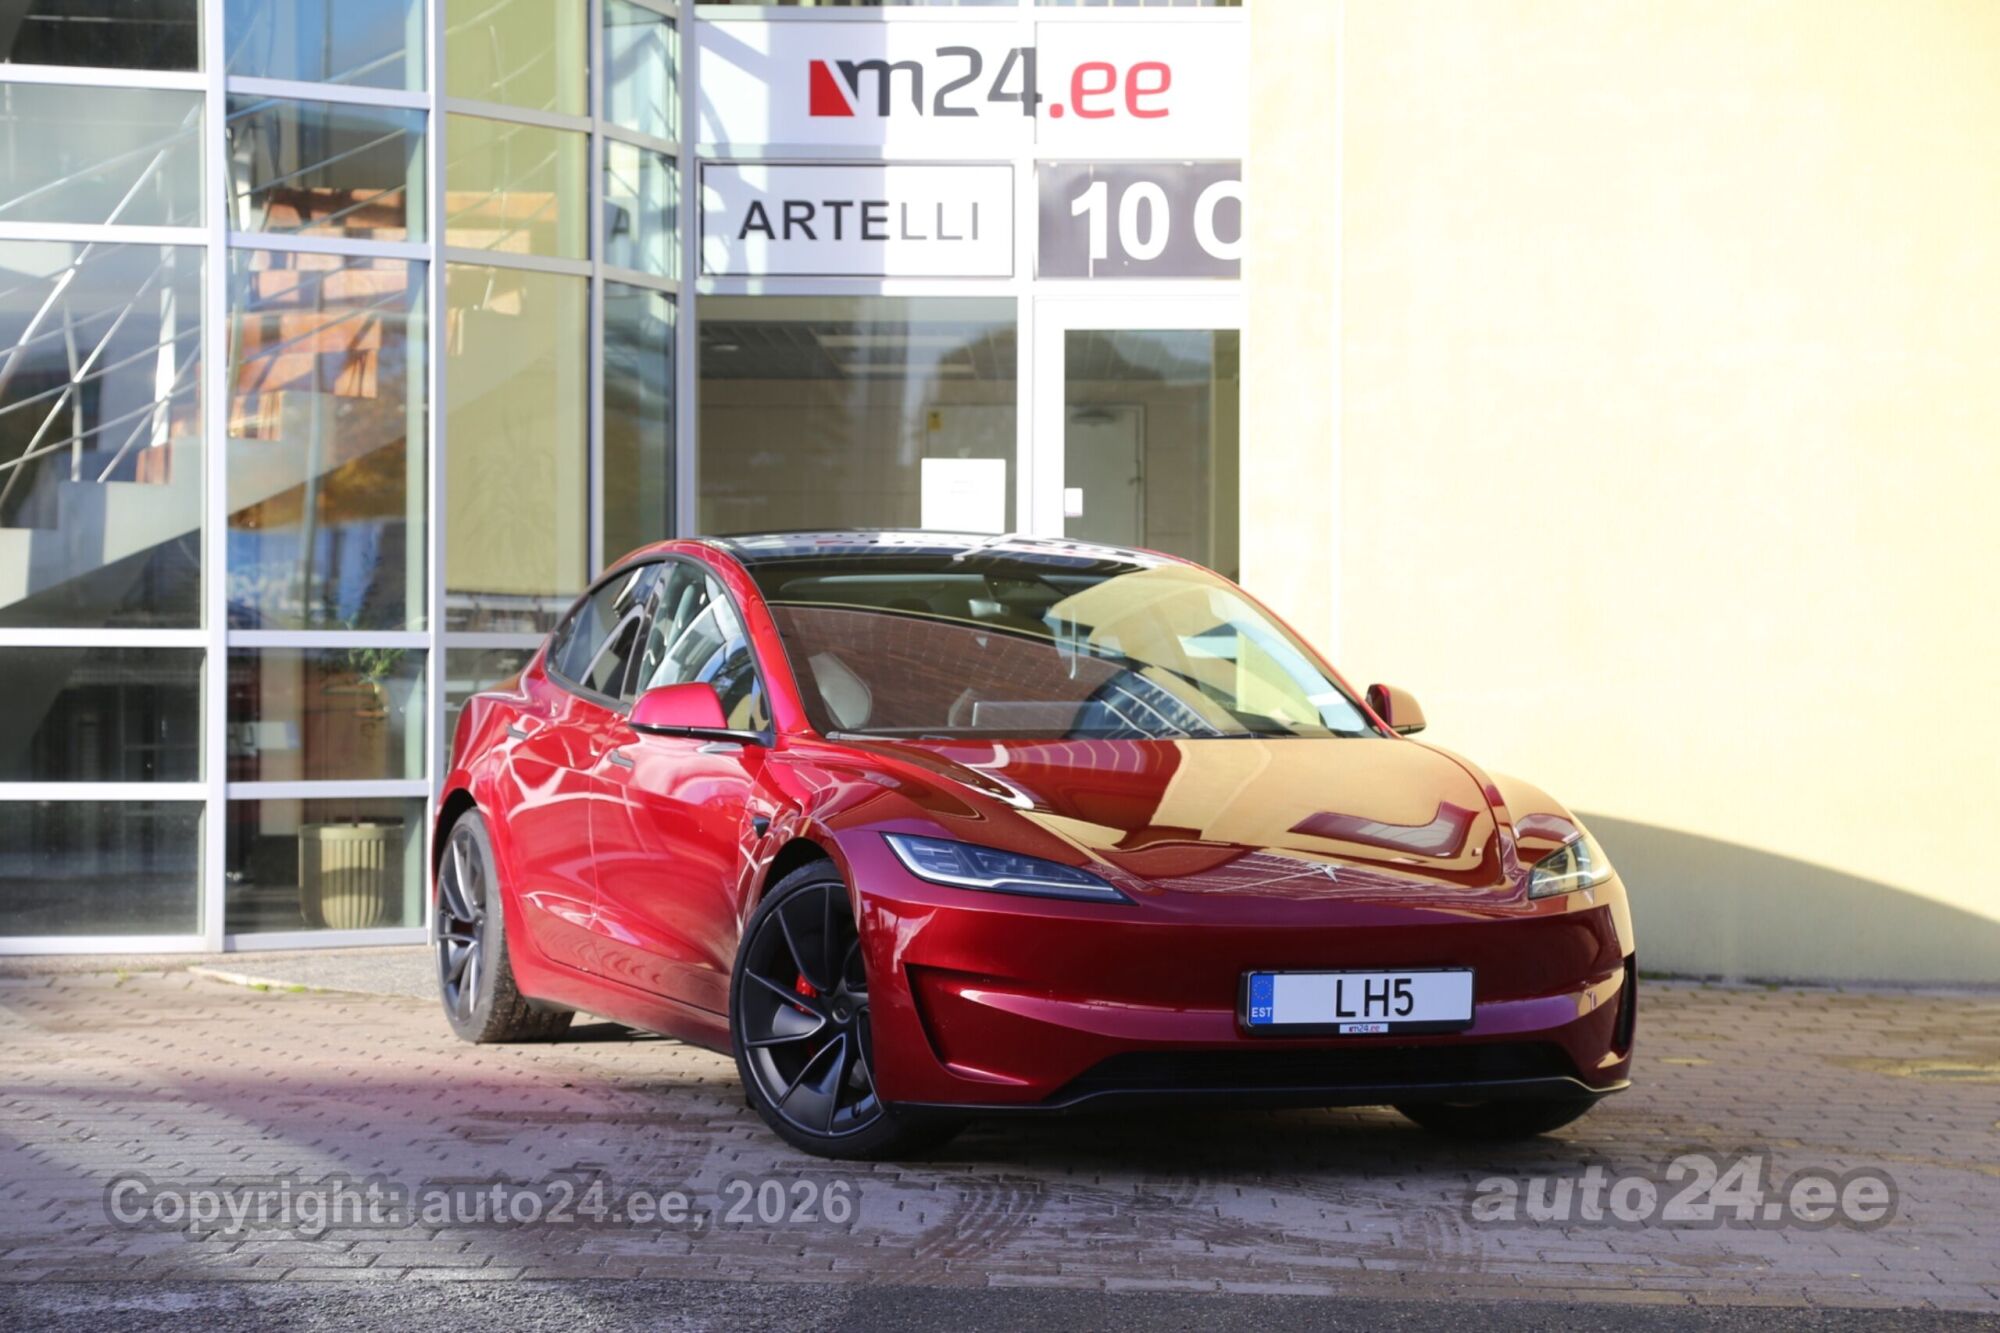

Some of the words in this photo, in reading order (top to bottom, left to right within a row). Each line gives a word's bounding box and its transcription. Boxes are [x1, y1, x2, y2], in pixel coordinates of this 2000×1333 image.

[835, 46, 1171, 119] m24.ee
[737, 200, 979, 241] ARTELLI
[1071, 181, 1170, 261] 10
[1251, 1006, 1273, 1018] EST
[1335, 978, 1415, 1018] LH5
